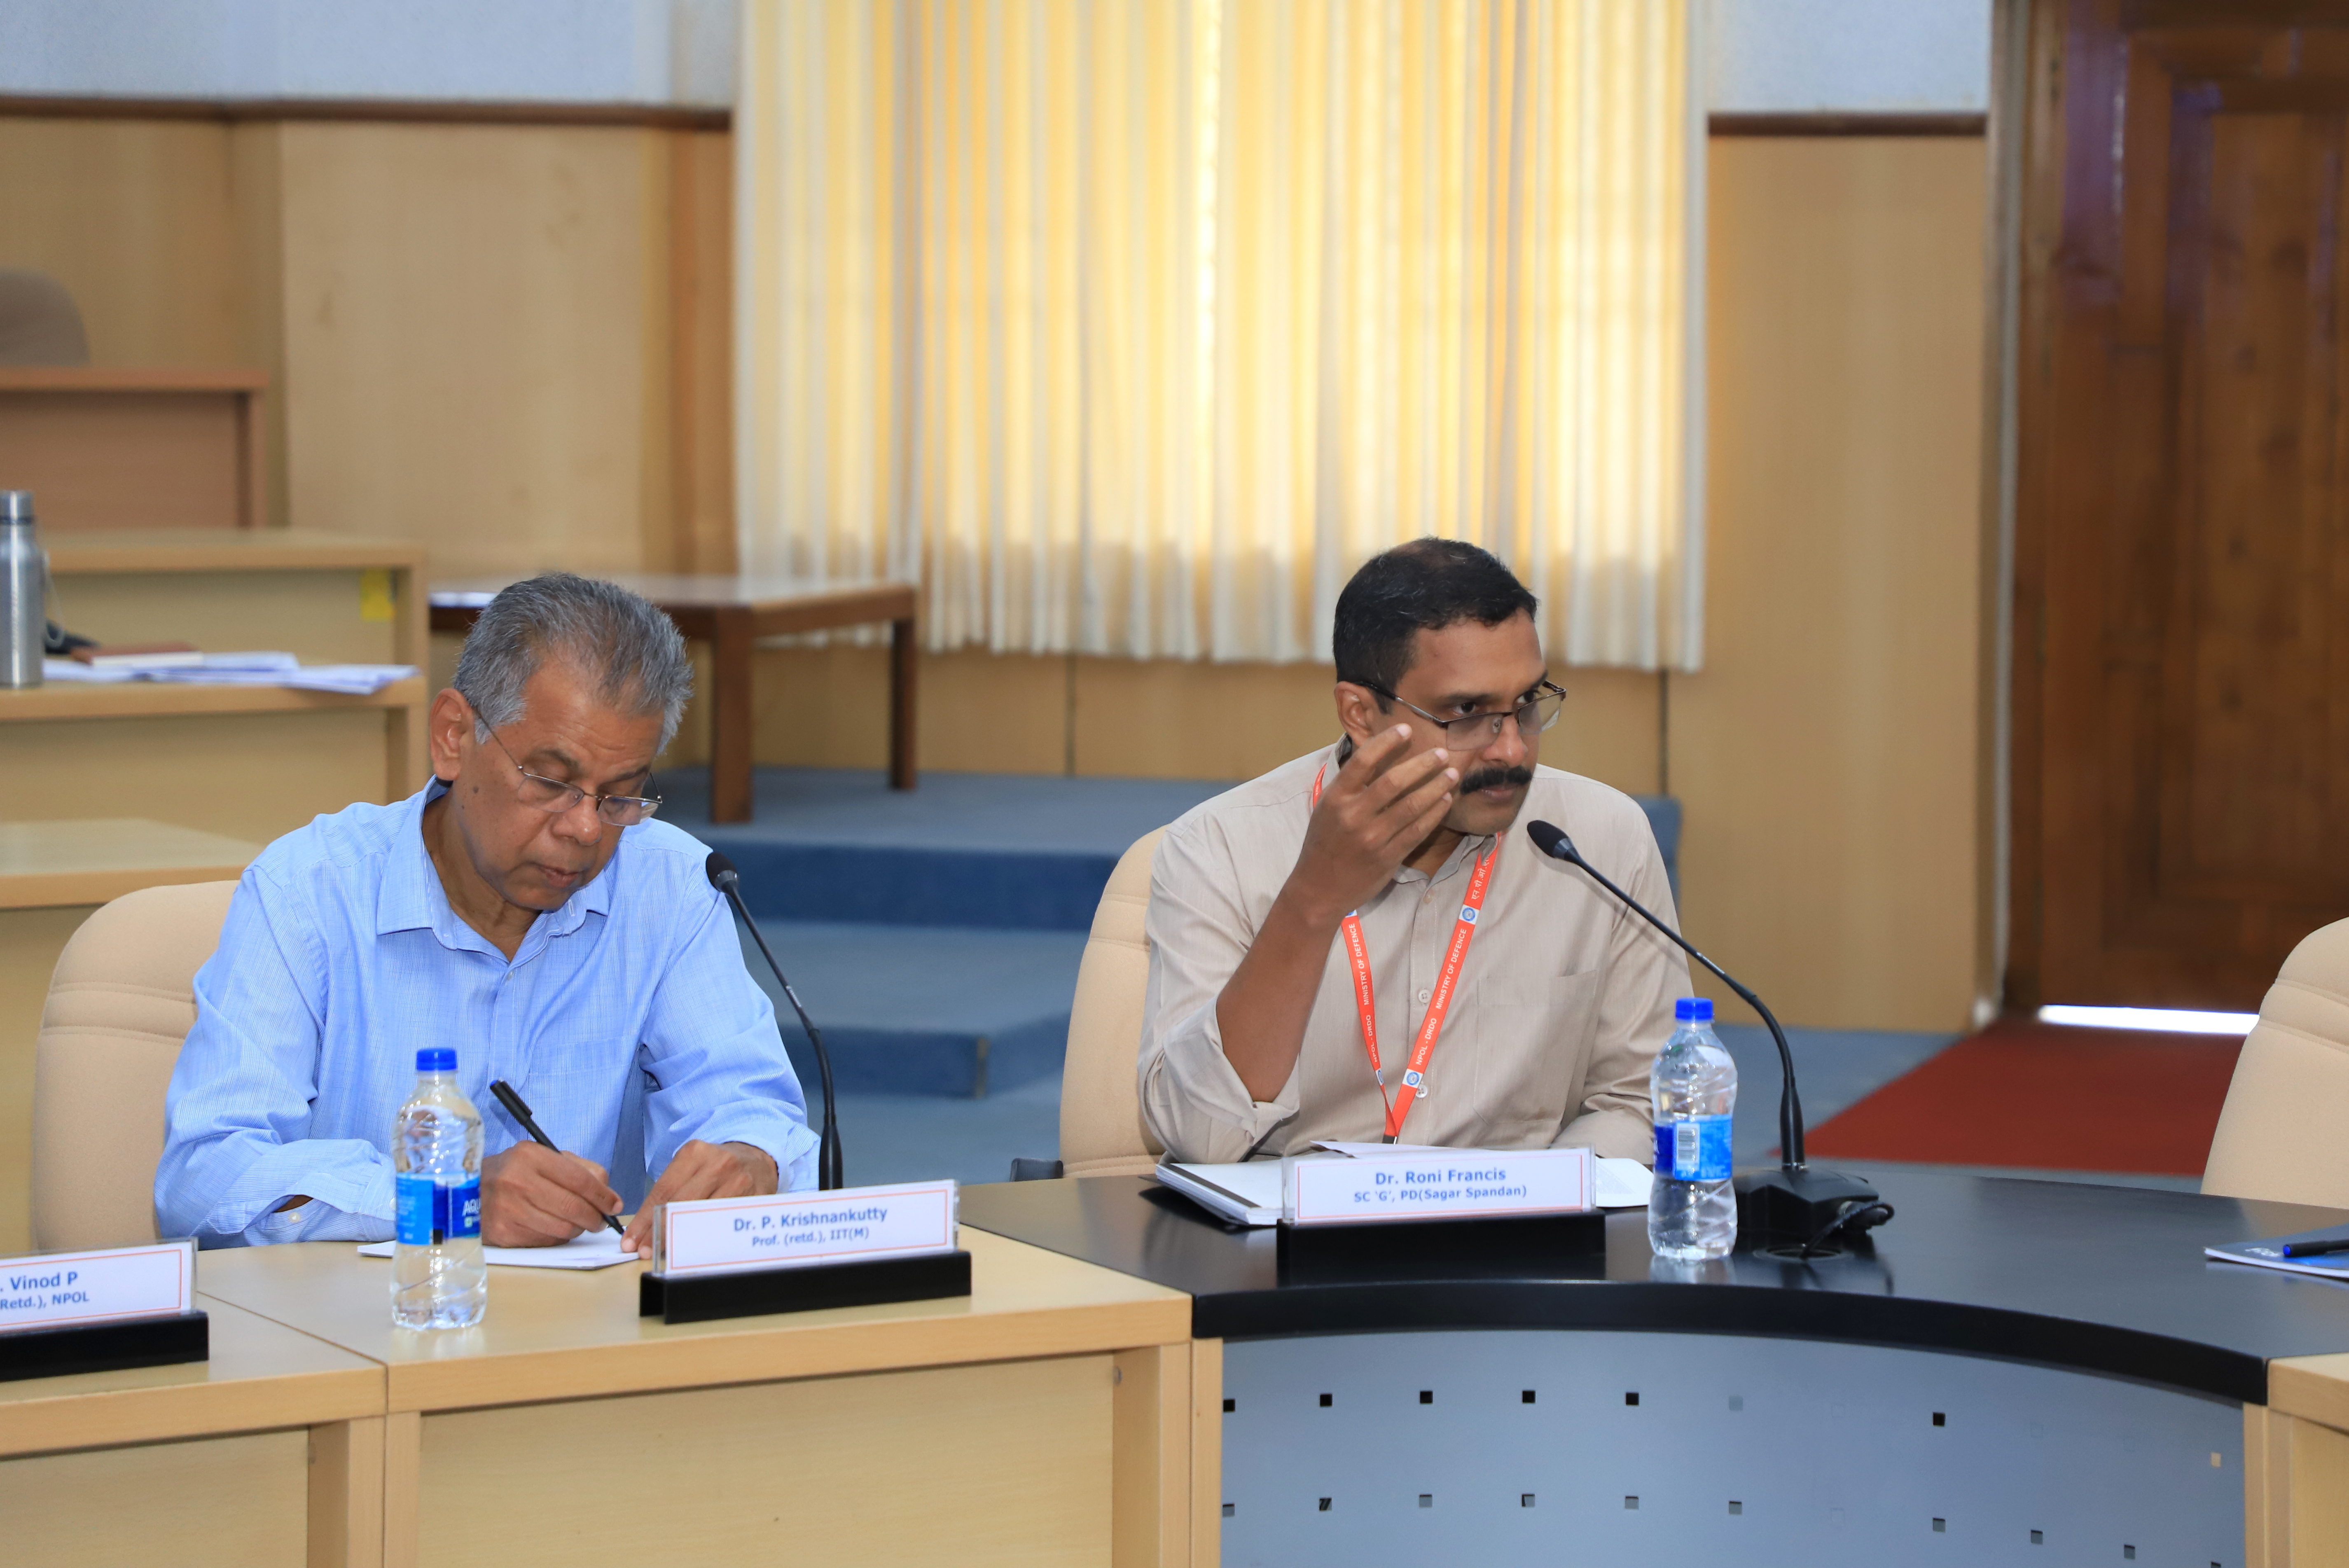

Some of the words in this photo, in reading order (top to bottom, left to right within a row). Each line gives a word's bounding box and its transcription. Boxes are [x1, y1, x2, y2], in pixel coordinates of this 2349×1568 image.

[1349, 923, 1362, 957] DEFENCE
[1358, 959, 1365, 969] OF
[1360, 971, 1370, 1005] MINISTRY
[1416, 1045, 1428, 1065] NPOL
[1425, 1018, 1437, 1040] DRDO
[1435, 975, 1451, 1009] MINISTRY
[1447, 963, 1455, 974] OF
[1451, 928, 1467, 963] DEFENCE
[1376, 1173, 1398, 1185] Dr.
[1406, 1169, 1442, 1184] Roni
[1448, 1167, 1506, 1182] Francis
[1354, 1192, 1371, 1202] SC
[1400, 1188, 1461, 1201] PD(Sagar
[1466, 1184, 1527, 1199] Spandan)
[734, 1218, 756, 1231] Dr.
[762, 1216, 775, 1229] P.
[781, 1208, 887, 1227] Krishnankutty
[752, 1234, 780, 1247] Prof.
[831, 1227, 869, 1242] IIT(M)
[10, 1272, 61, 1290] Vinod
[68, 1271, 78, 1285] P
[52, 1291, 89, 1304] NPOL
